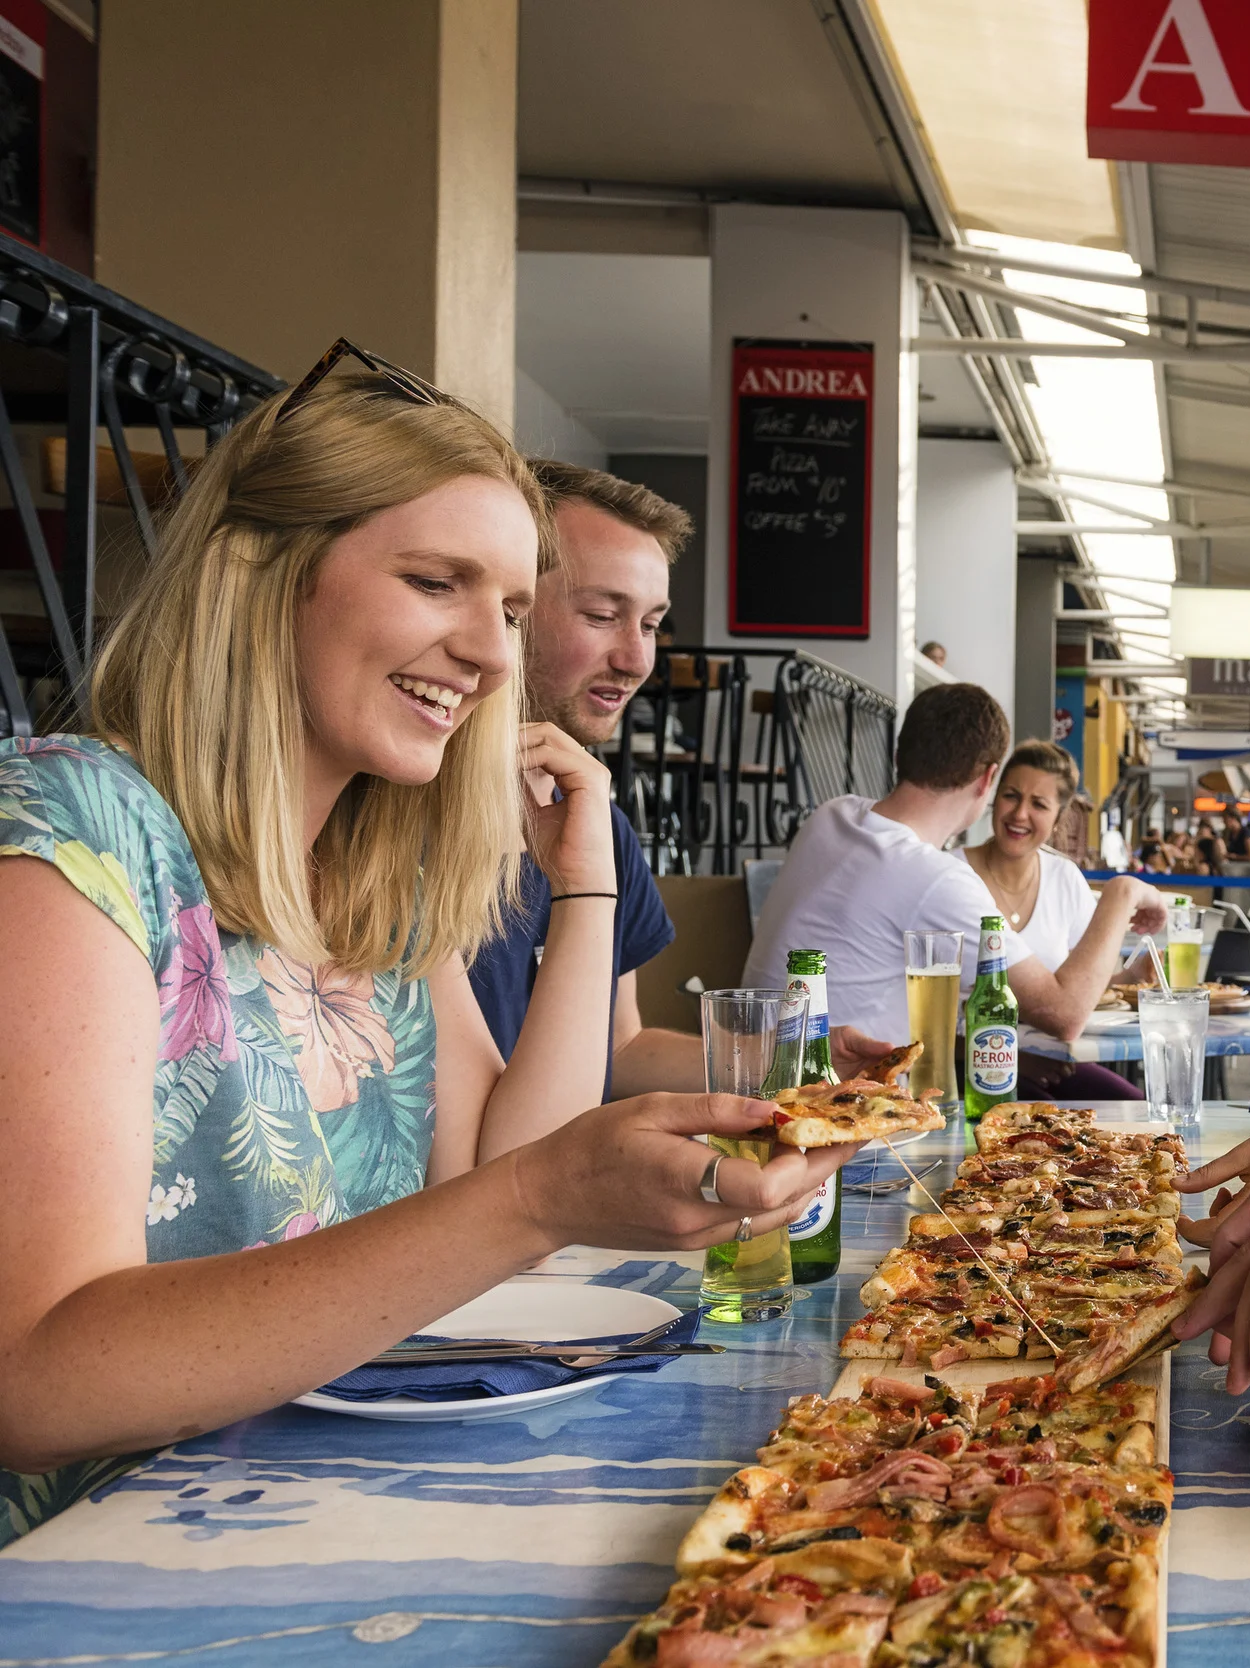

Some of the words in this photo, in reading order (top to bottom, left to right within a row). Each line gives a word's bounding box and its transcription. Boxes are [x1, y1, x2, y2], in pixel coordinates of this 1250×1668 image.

[738, 367, 867, 396] ANDREA
[752, 406, 795, 435] TAKE
[802, 413, 858, 439] AWAY
[769, 446, 818, 474] PIZZA
[746, 473, 799, 497] FROM
[973, 1050, 1015, 1063] PERONI
